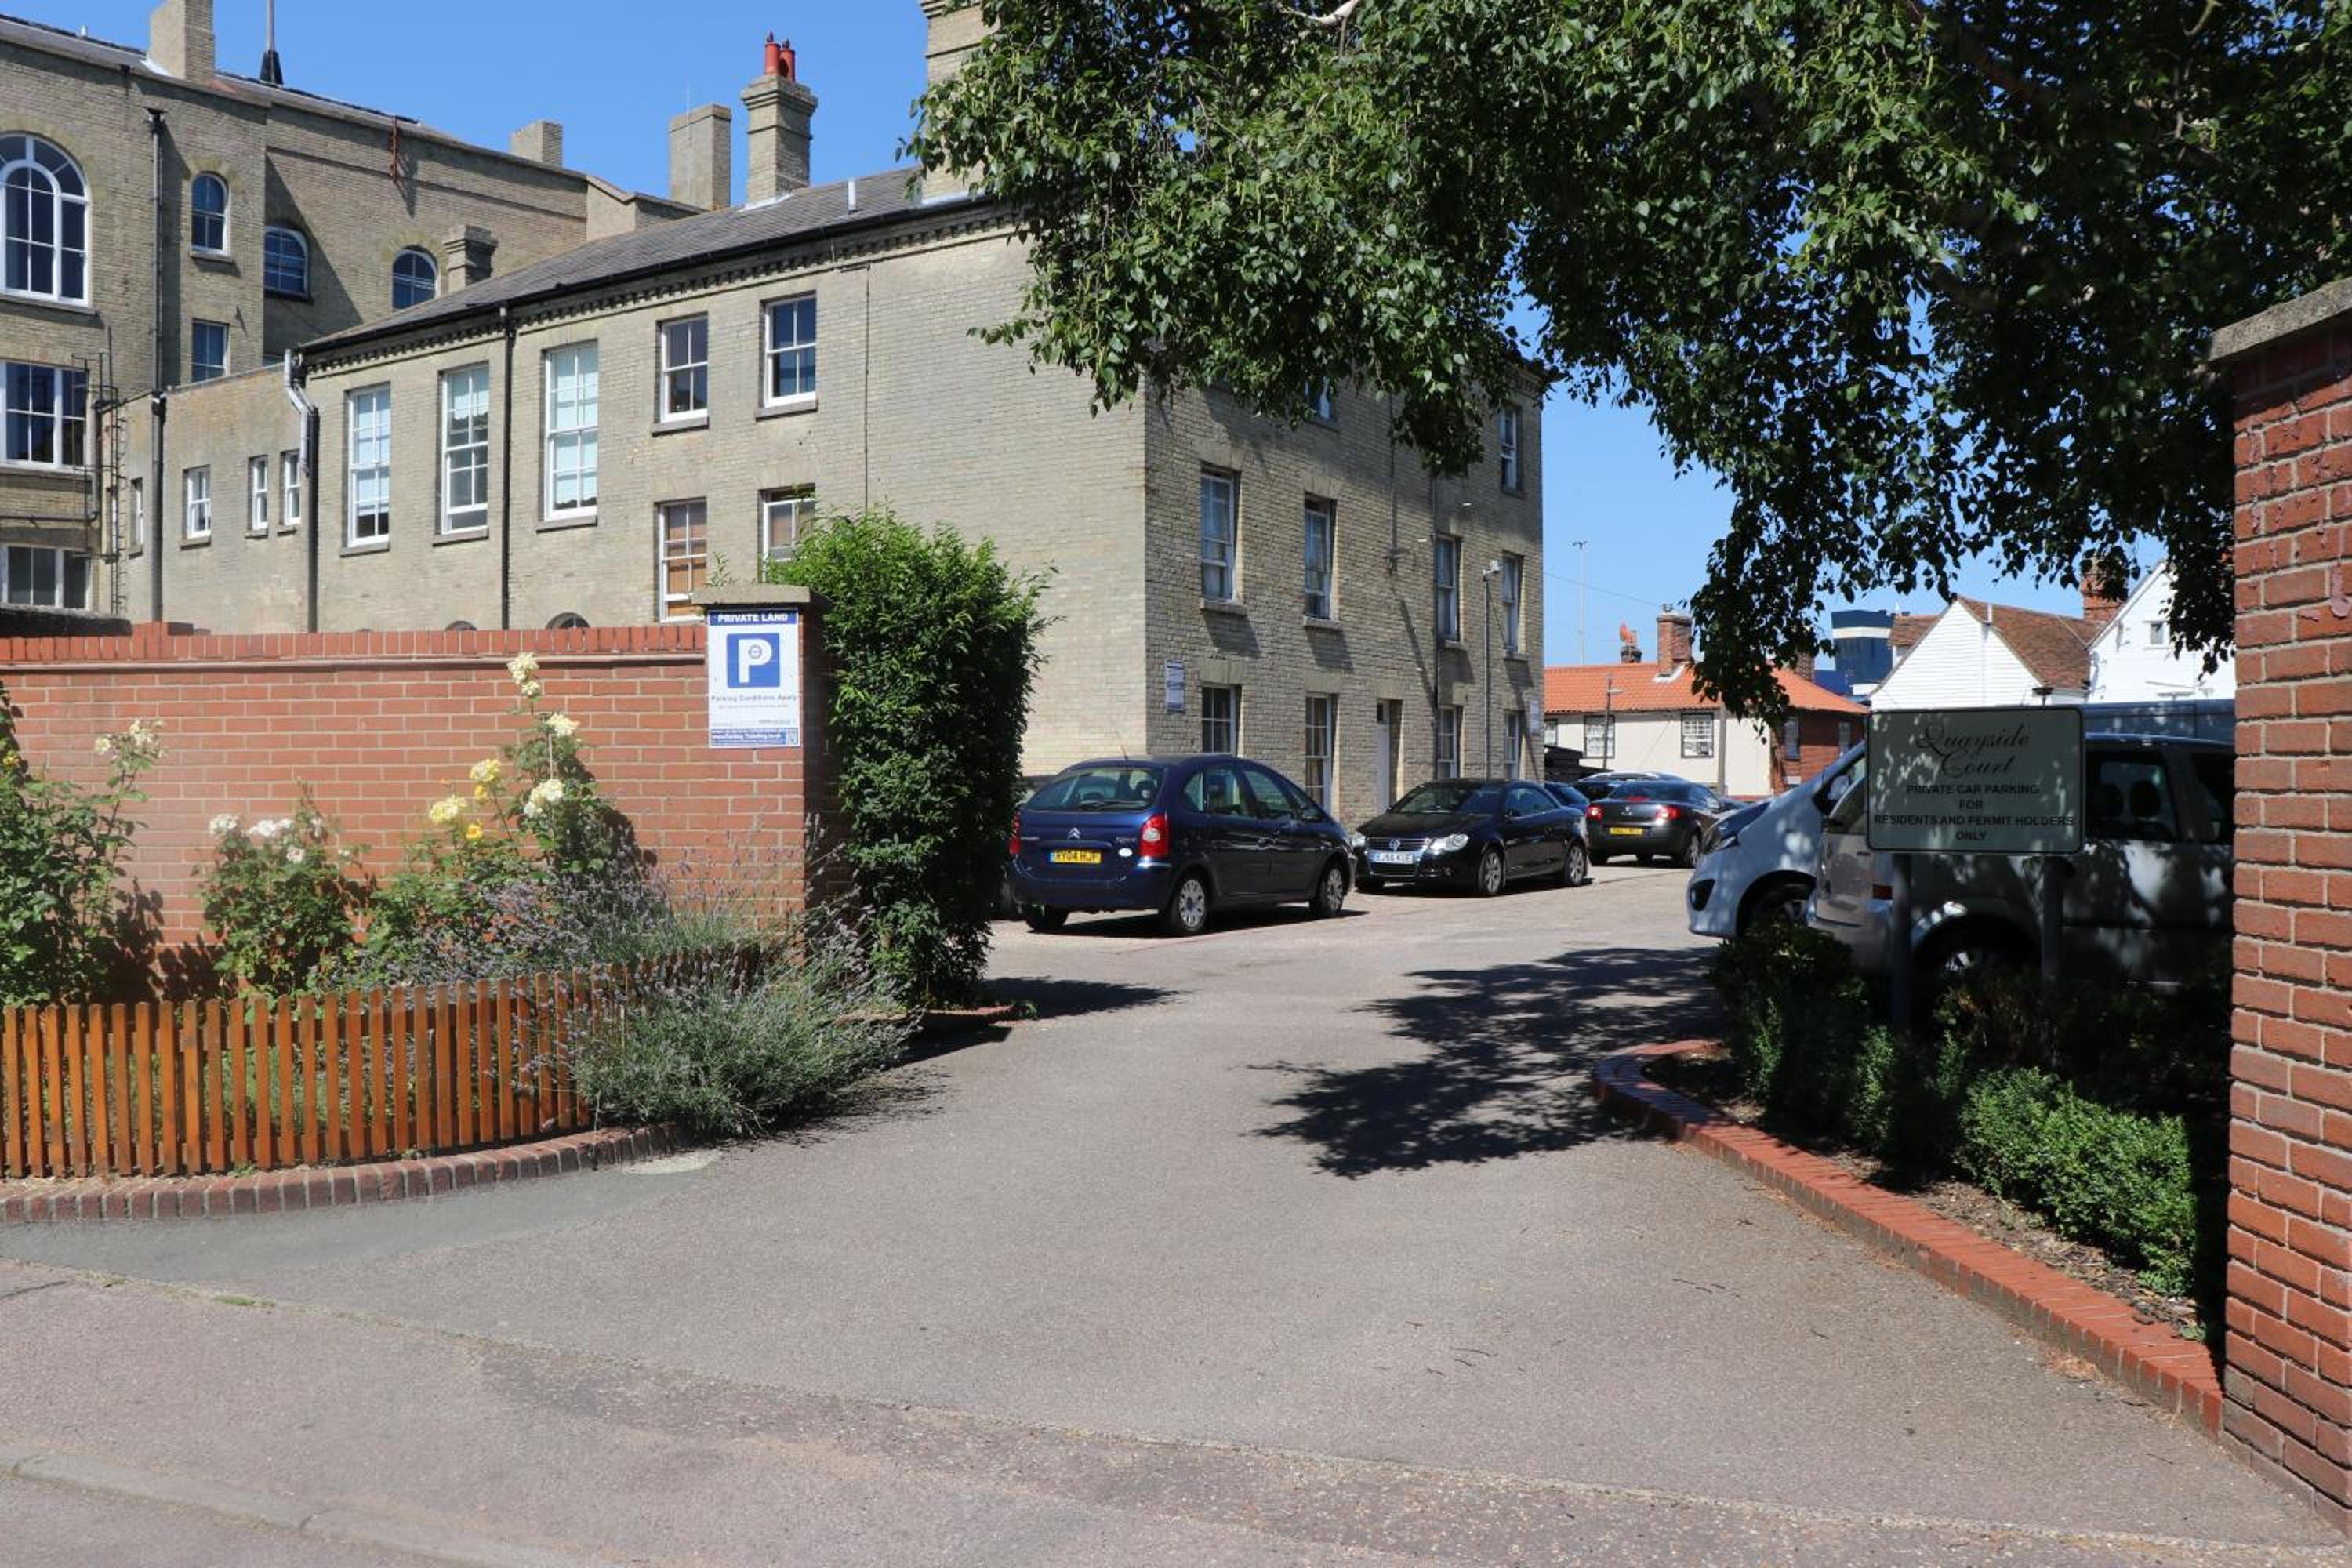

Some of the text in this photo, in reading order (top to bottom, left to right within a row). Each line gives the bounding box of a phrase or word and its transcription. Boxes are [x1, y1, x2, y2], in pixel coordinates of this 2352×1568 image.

[717, 613, 788, 622] PRIVATE LAND
[738, 638, 772, 683] P
[1916, 723, 2030, 757] Quayside
[1940, 748, 2015, 778] Court
[1907, 784, 2040, 794] PRIVATE CAR PARKING
[1959, 800, 1983, 810] FOR
[1875, 815, 2076, 826] RESIDENTS AND PERMIT HOLDERS
[1956, 831, 1987, 841] ONLY
